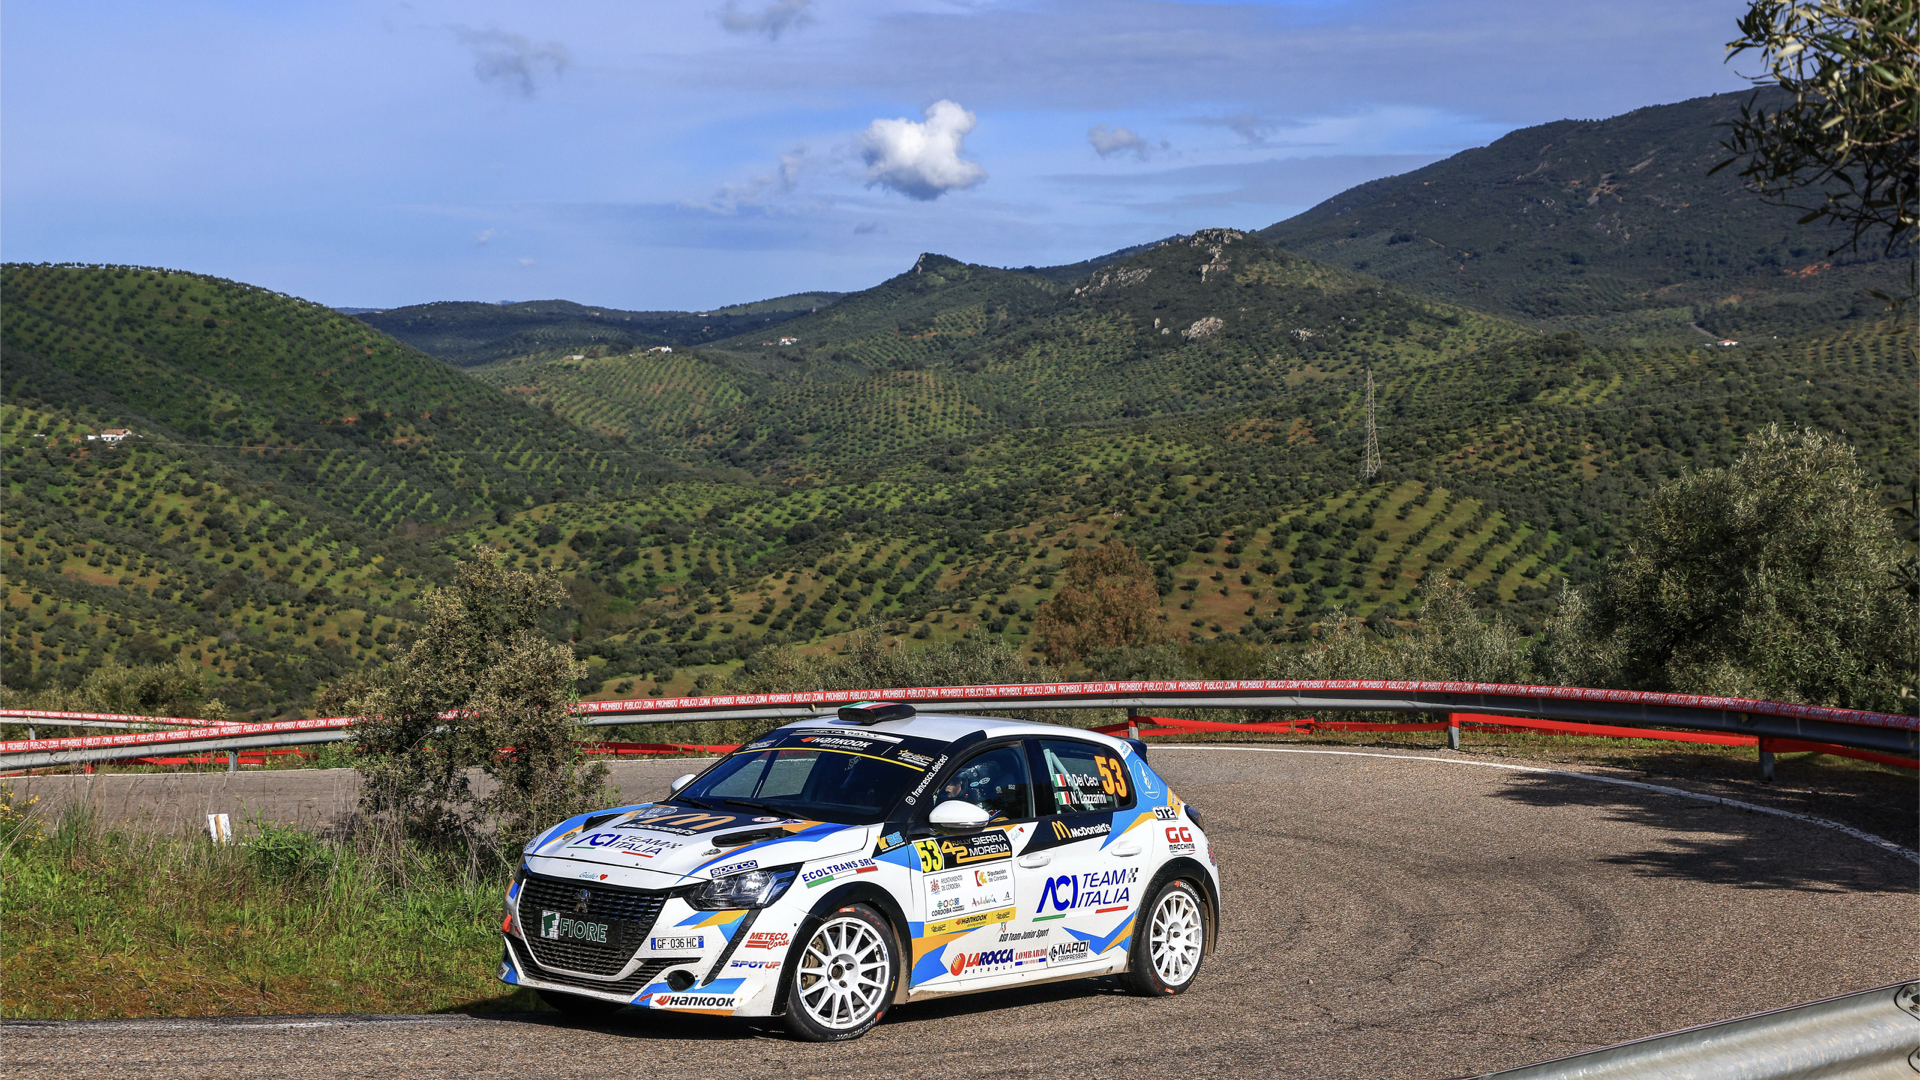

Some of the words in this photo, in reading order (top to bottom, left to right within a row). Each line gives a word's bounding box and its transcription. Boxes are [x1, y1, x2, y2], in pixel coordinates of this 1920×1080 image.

[588, 702, 599, 711] ZONA
[601, 701, 622, 711] PROHIBIDO
[624, 701, 642, 710] PUBLICO
[643, 700, 654, 709] ZONA
[655, 699, 678, 708] PROHIBIDO
[679, 698, 697, 707] PUBLICO
[699, 697, 710, 706] ZONA
[712, 696, 735, 705] PROHIBIDO
[735, 695, 754, 704] PUBLICO
[755, 695, 767, 704] ZONA
[769, 694, 792, 703] PROHIBIDO
[793, 693, 811, 702] PUBLICO
[811, 693, 824, 701] ZONA
[825, 692, 848, 701] PROHIBIDO
[849, 691, 868, 700] PUBLICO
[868, 690, 881, 699] ZONA
[882, 690, 906, 698] PROHIBIDO
[907, 689, 926, 698] PUBLICO
[927, 689, 939, 698] ZONA
[940, 688, 964, 697] PROHIBIDO
[965, 688, 984, 696] PUBLICO
[985, 687, 997, 696] ZONA
[999, 686, 1022, 695] PROHIBIDO
[1024, 686, 1042, 695] PUBLICO
[1044, 685, 1056, 694] ZONA
[1057, 684, 1082, 693] PROHIBIDO
[1083, 683, 1103, 692] PUBLICO
[1104, 682, 1117, 691] ZONA
[1118, 682, 1142, 691] PROHIBIDO
[1143, 682, 1163, 691] PUBLICO
[1165, 682, 1177, 690] ZONA
[1178, 681, 1202, 690] PROHIBIDO
[1203, 681, 1223, 689] PUBLICO
[1225, 680, 1237, 689] ZONA
[1239, 680, 1264, 689] PROHIBIDO
[1265, 680, 1286, 689] PUBLICO
[1287, 681, 1300, 689] ZONA
[1346, 680, 1359, 688] ZONA
[7, 742, 28, 750] PROHIBIDO
[30, 741, 47, 749] PUBLICO
[48, 740, 59, 748] ZONA
[60, 738, 82, 747] PROHIBIDO
[83, 737, 101, 746] PUBLICO
[101, 736, 113, 744] ZONA
[114, 734, 136, 743] PROHIBIDO
[137, 732, 154, 741] PUBLICO
[155, 731, 166, 740] ZONA
[167, 729, 188, 739] PROHIBIDO
[190, 728, 207, 738] PUBLICO
[208, 727, 219, 736] ZONA
[220, 725, 242, 734] PROHIBIDO
[243, 724, 260, 732] PUBLICO
[262, 722, 273, 730] ZONA
[274, 721, 295, 729] PROHIBIDO
[296, 720, 314, 728] PUBLICO
[315, 719, 326, 727] ZONA
[328, 717, 350, 726] PROHIBIDO
[911, 753, 949, 798] francesco_deiceci
[1073, 774, 1083, 787] Dei
[1093, 755, 1127, 798] 53
[1071, 791, 1079, 804] N.
[1080, 790, 1107, 804] Lazzarini
[1070, 823, 1112, 838] McDonald's
[1165, 827, 1192, 844] GG
[573, 833, 621, 847] ACI
[626, 835, 665, 847] TEAM
[952, 838, 971, 846] RALLY
[971, 834, 1006, 846] SIERRA
[610, 842, 663, 855] ITALIA
[969, 843, 1010, 857] MORENA
[914, 840, 943, 873] 53
[711, 861, 757, 876] sparco
[801, 860, 858, 882] ECOLTRANS
[859, 857, 876, 869] SRL
[1036, 875, 1078, 914] ACI
[1082, 869, 1127, 890] TEAM
[1078, 887, 1130, 908] ITALIA
[559, 918, 609, 943] FIORE
[749, 932, 788, 941] METECO
[1009, 932, 1022, 941] Team
[1021, 930, 1037, 940] Junior
[1036, 928, 1050, 939] Sport
[686, 937, 697, 948] HC
[766, 938, 790, 950] Corse
[1058, 941, 1089, 955] NARDI
[1015, 948, 1047, 960] LOMBARDI
[1057, 952, 1087, 961] COMPRESSORI
[730, 960, 781, 969] SPOTUP
